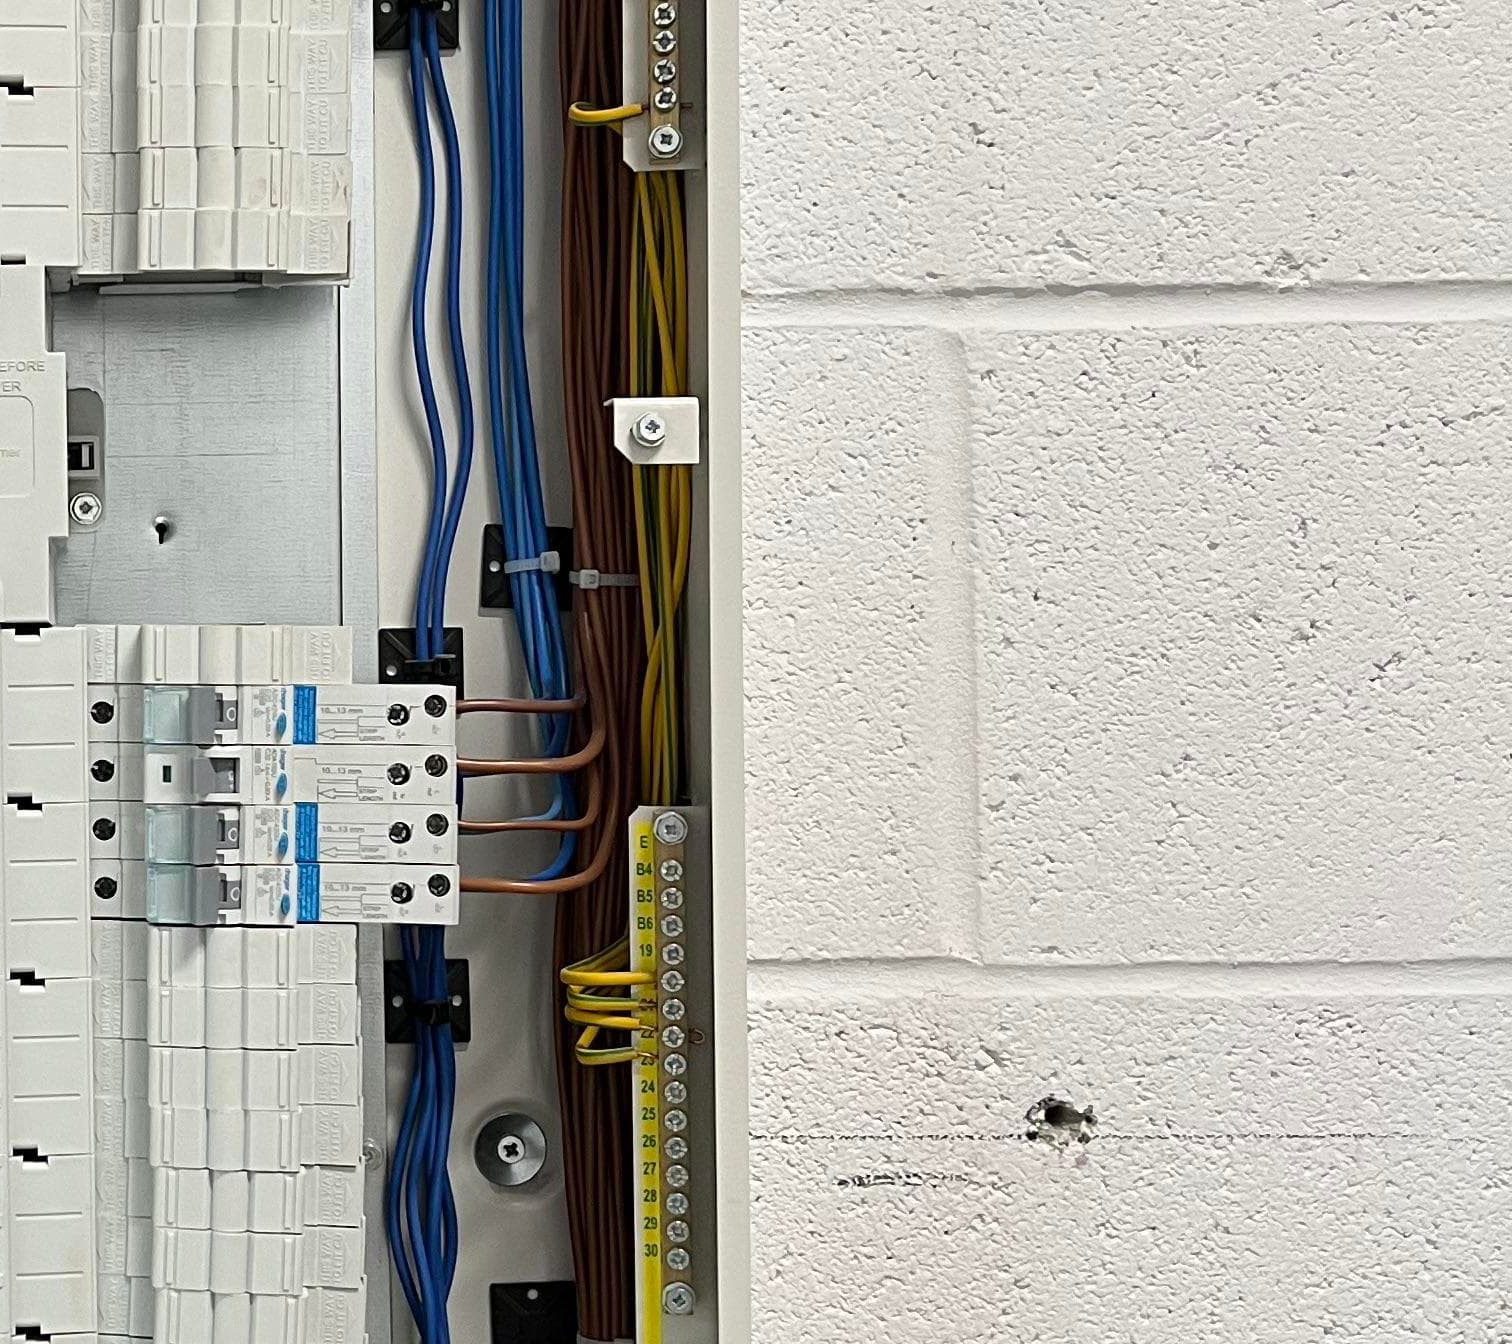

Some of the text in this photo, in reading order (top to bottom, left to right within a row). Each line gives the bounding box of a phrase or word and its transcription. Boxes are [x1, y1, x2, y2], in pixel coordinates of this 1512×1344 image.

[640, 836, 648, 848] E
[637, 863, 653, 875] B4
[637, 890, 653, 903] B5
[638, 917, 653, 929] B6
[640, 944, 653, 956] 19
[641, 1080, 655, 1093] 24
[642, 1108, 656, 1120] 25
[643, 1135, 656, 1147] 26
[643, 1162, 656, 1175] 27
[644, 1190, 657, 1202] 28
[644, 1217, 658, 1229] 29
[644, 1244, 658, 1256] 30
